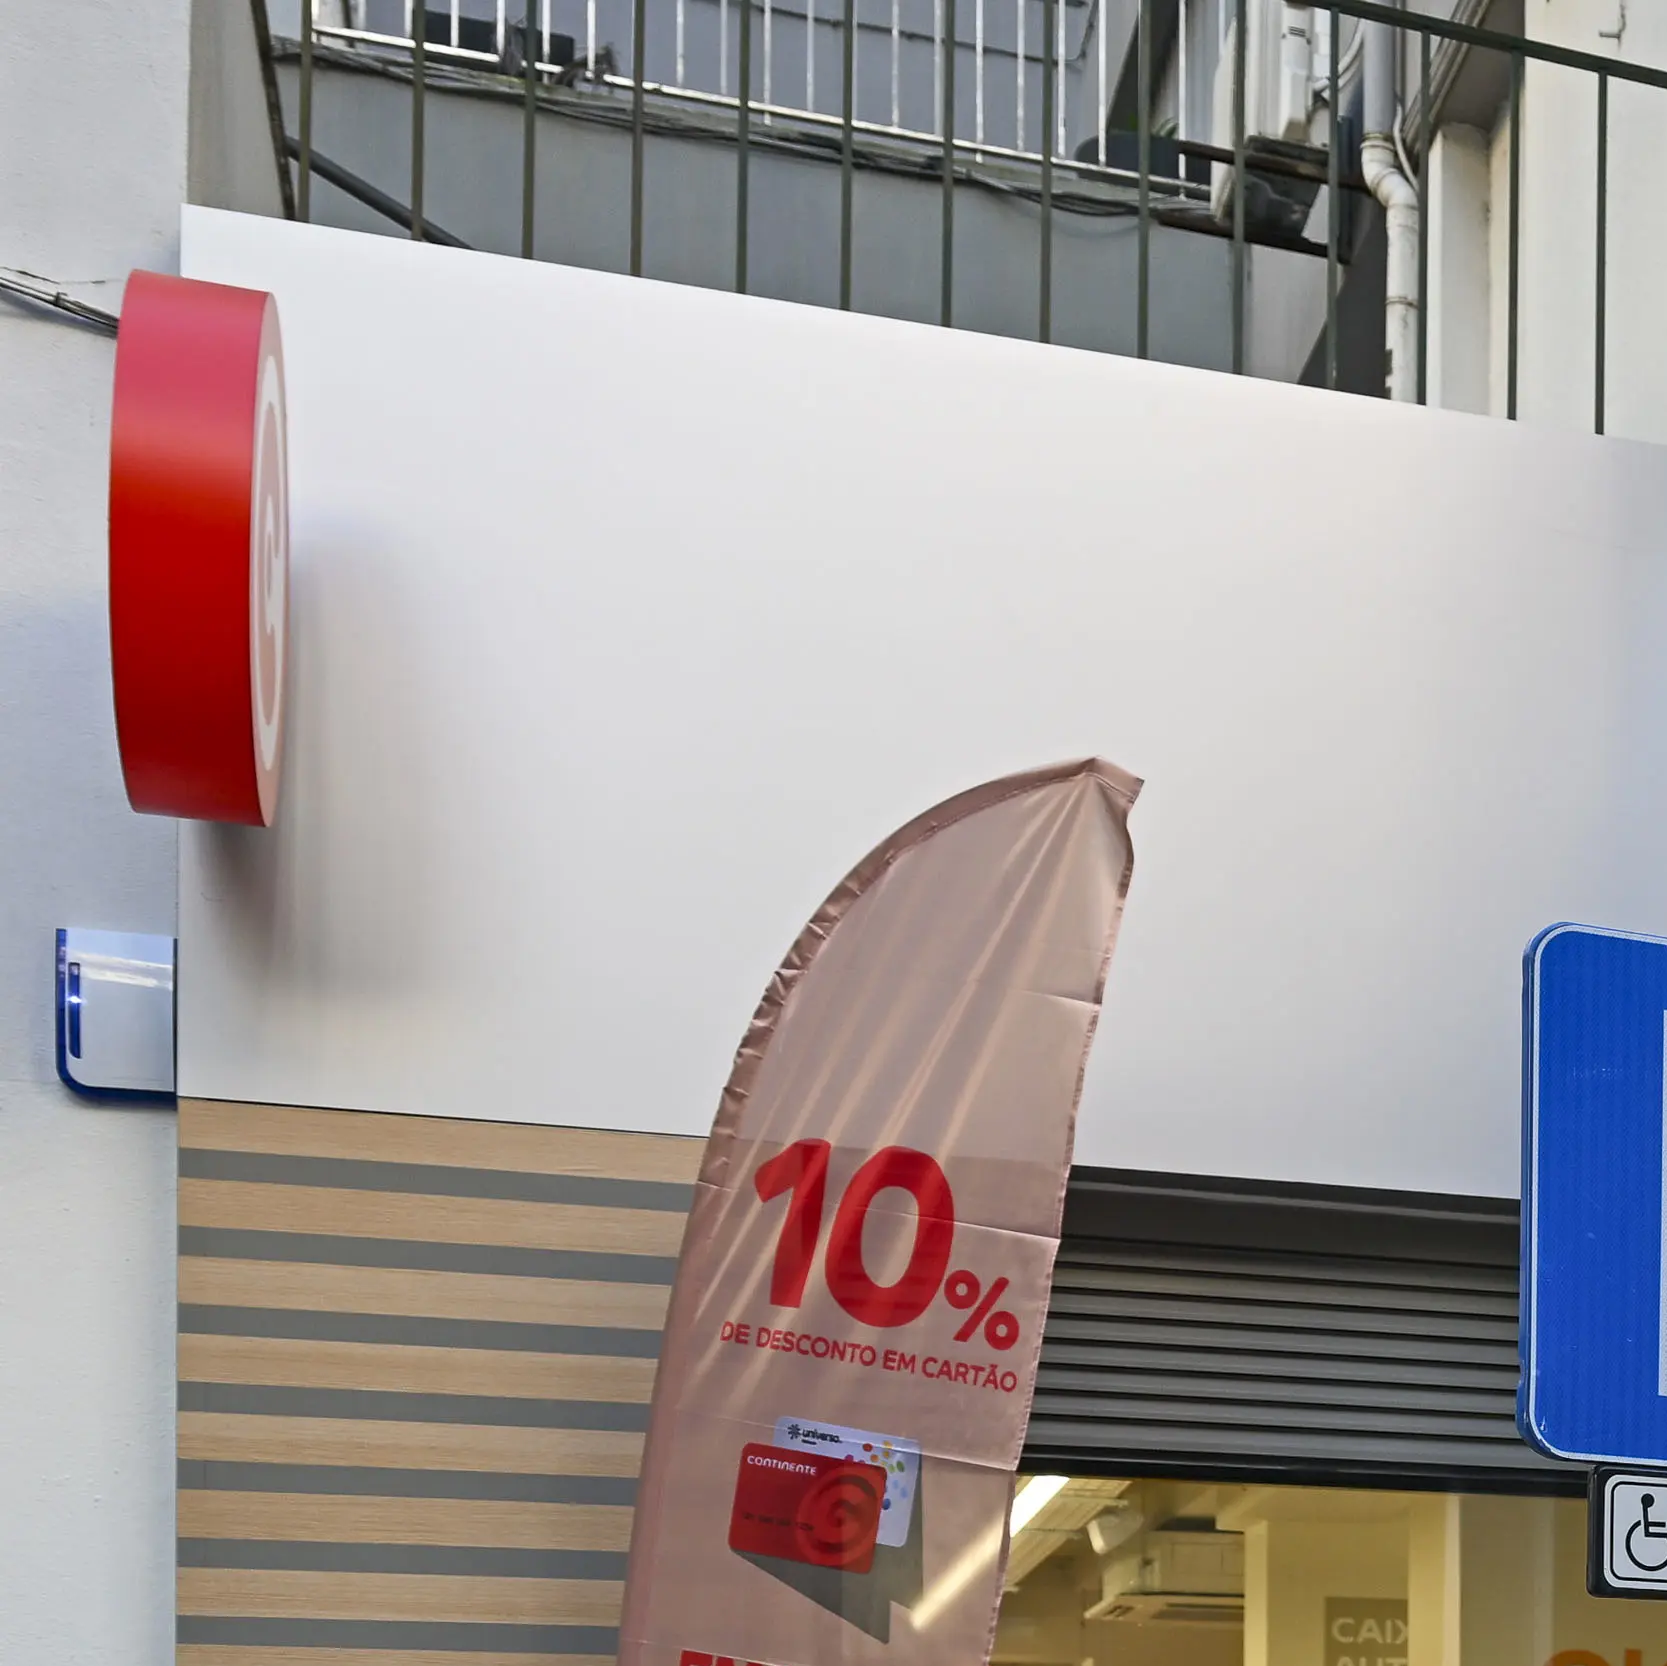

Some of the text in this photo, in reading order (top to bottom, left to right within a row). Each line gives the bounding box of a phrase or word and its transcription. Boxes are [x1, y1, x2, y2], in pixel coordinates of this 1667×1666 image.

[754, 1137, 1020, 1351] 10%
[720, 1321, 1018, 1393] DE DESCONTO EM CARTÃO
[747, 1455, 818, 1476] CONTINENTE
